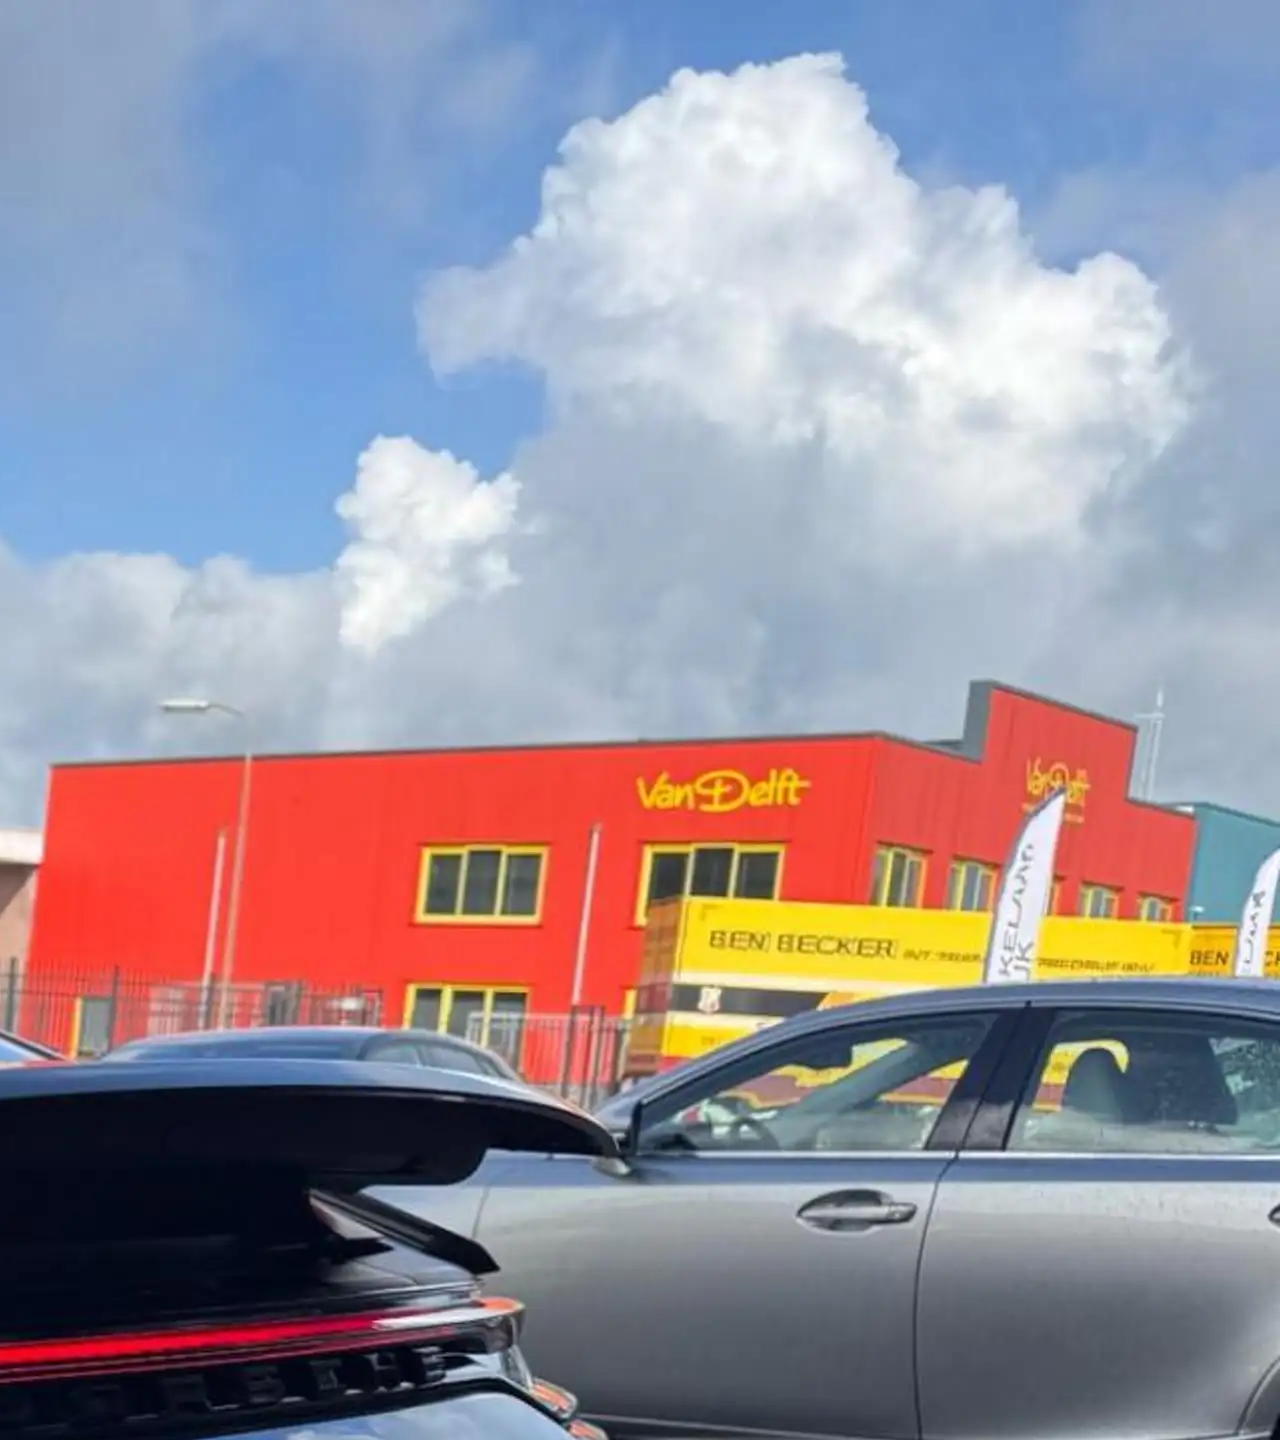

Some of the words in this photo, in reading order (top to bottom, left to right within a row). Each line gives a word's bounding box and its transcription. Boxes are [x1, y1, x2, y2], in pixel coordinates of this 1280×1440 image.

[636, 771, 695, 810] Van
[695, 768, 812, 813] Delft
[709, 929, 768, 952] BEN
[777, 933, 896, 959] BECKER
[1189, 949, 1230, 967] BEN
